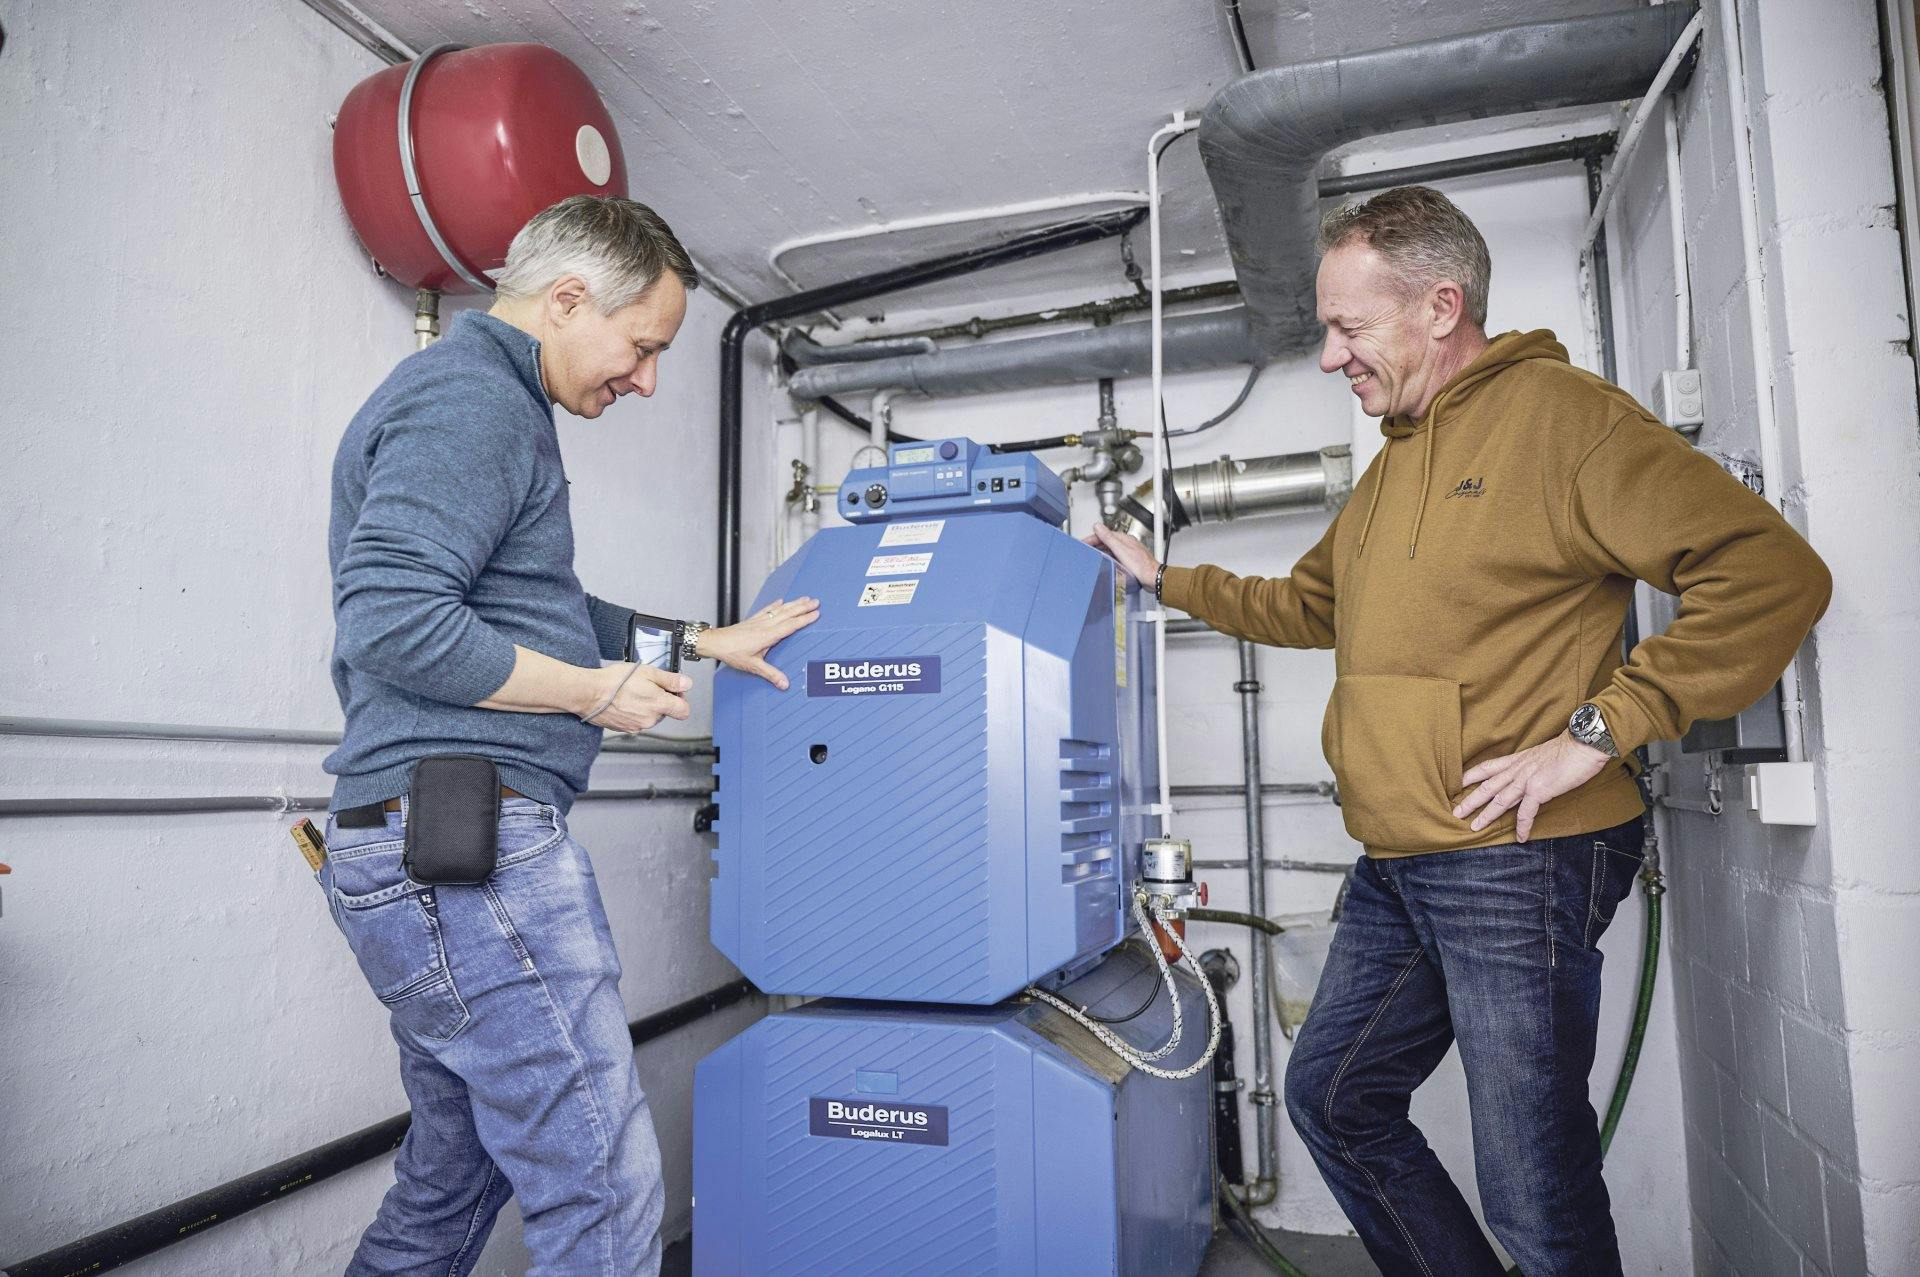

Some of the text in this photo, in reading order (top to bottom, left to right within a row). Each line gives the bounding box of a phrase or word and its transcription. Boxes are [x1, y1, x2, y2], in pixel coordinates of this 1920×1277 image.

[824, 662, 921, 679] Buderus
[841, 683, 904, 694] Logano G115
[827, 1101, 928, 1125] Buderus
[850, 1127, 905, 1140] Logalux LT
